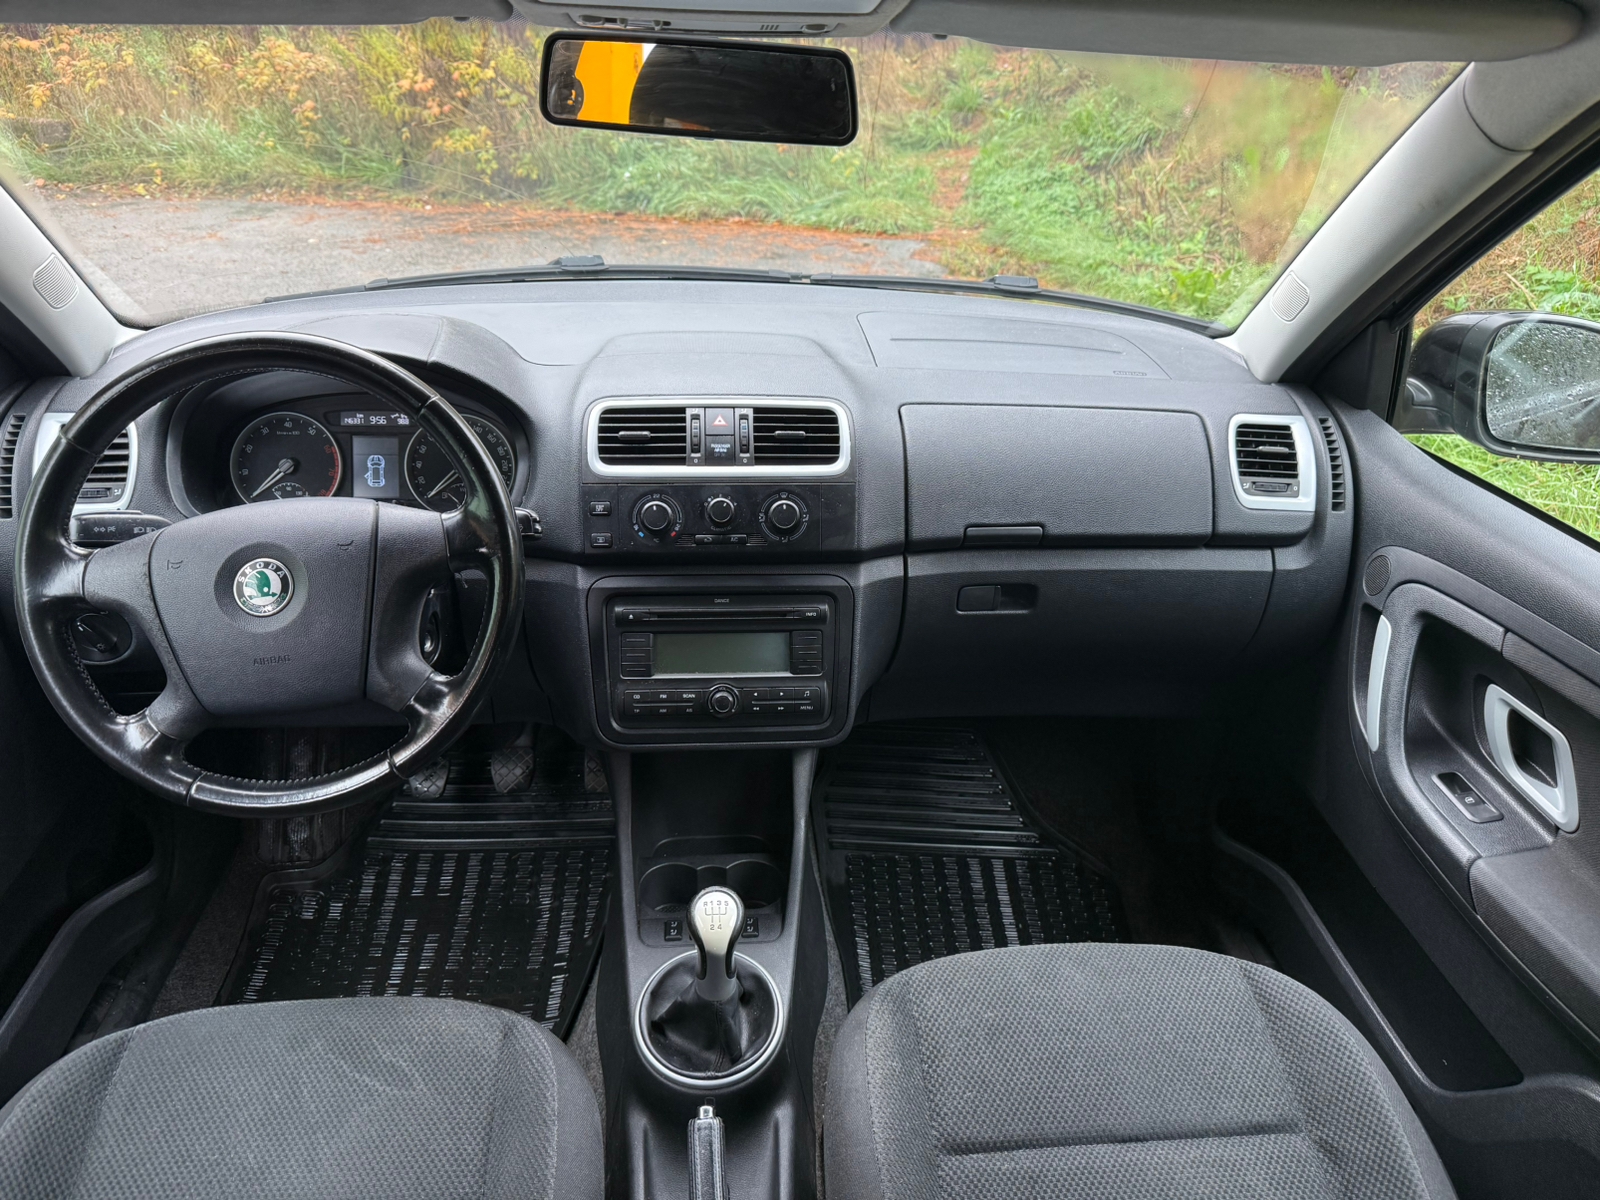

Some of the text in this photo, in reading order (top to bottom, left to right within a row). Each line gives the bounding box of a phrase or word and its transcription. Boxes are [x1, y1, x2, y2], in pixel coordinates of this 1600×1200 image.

[260, 426, 270, 436] 30
[307, 426, 316, 436] 50
[487, 433, 497, 444] 160
[245, 443, 253, 454] 20
[500, 459, 509, 472] 200
